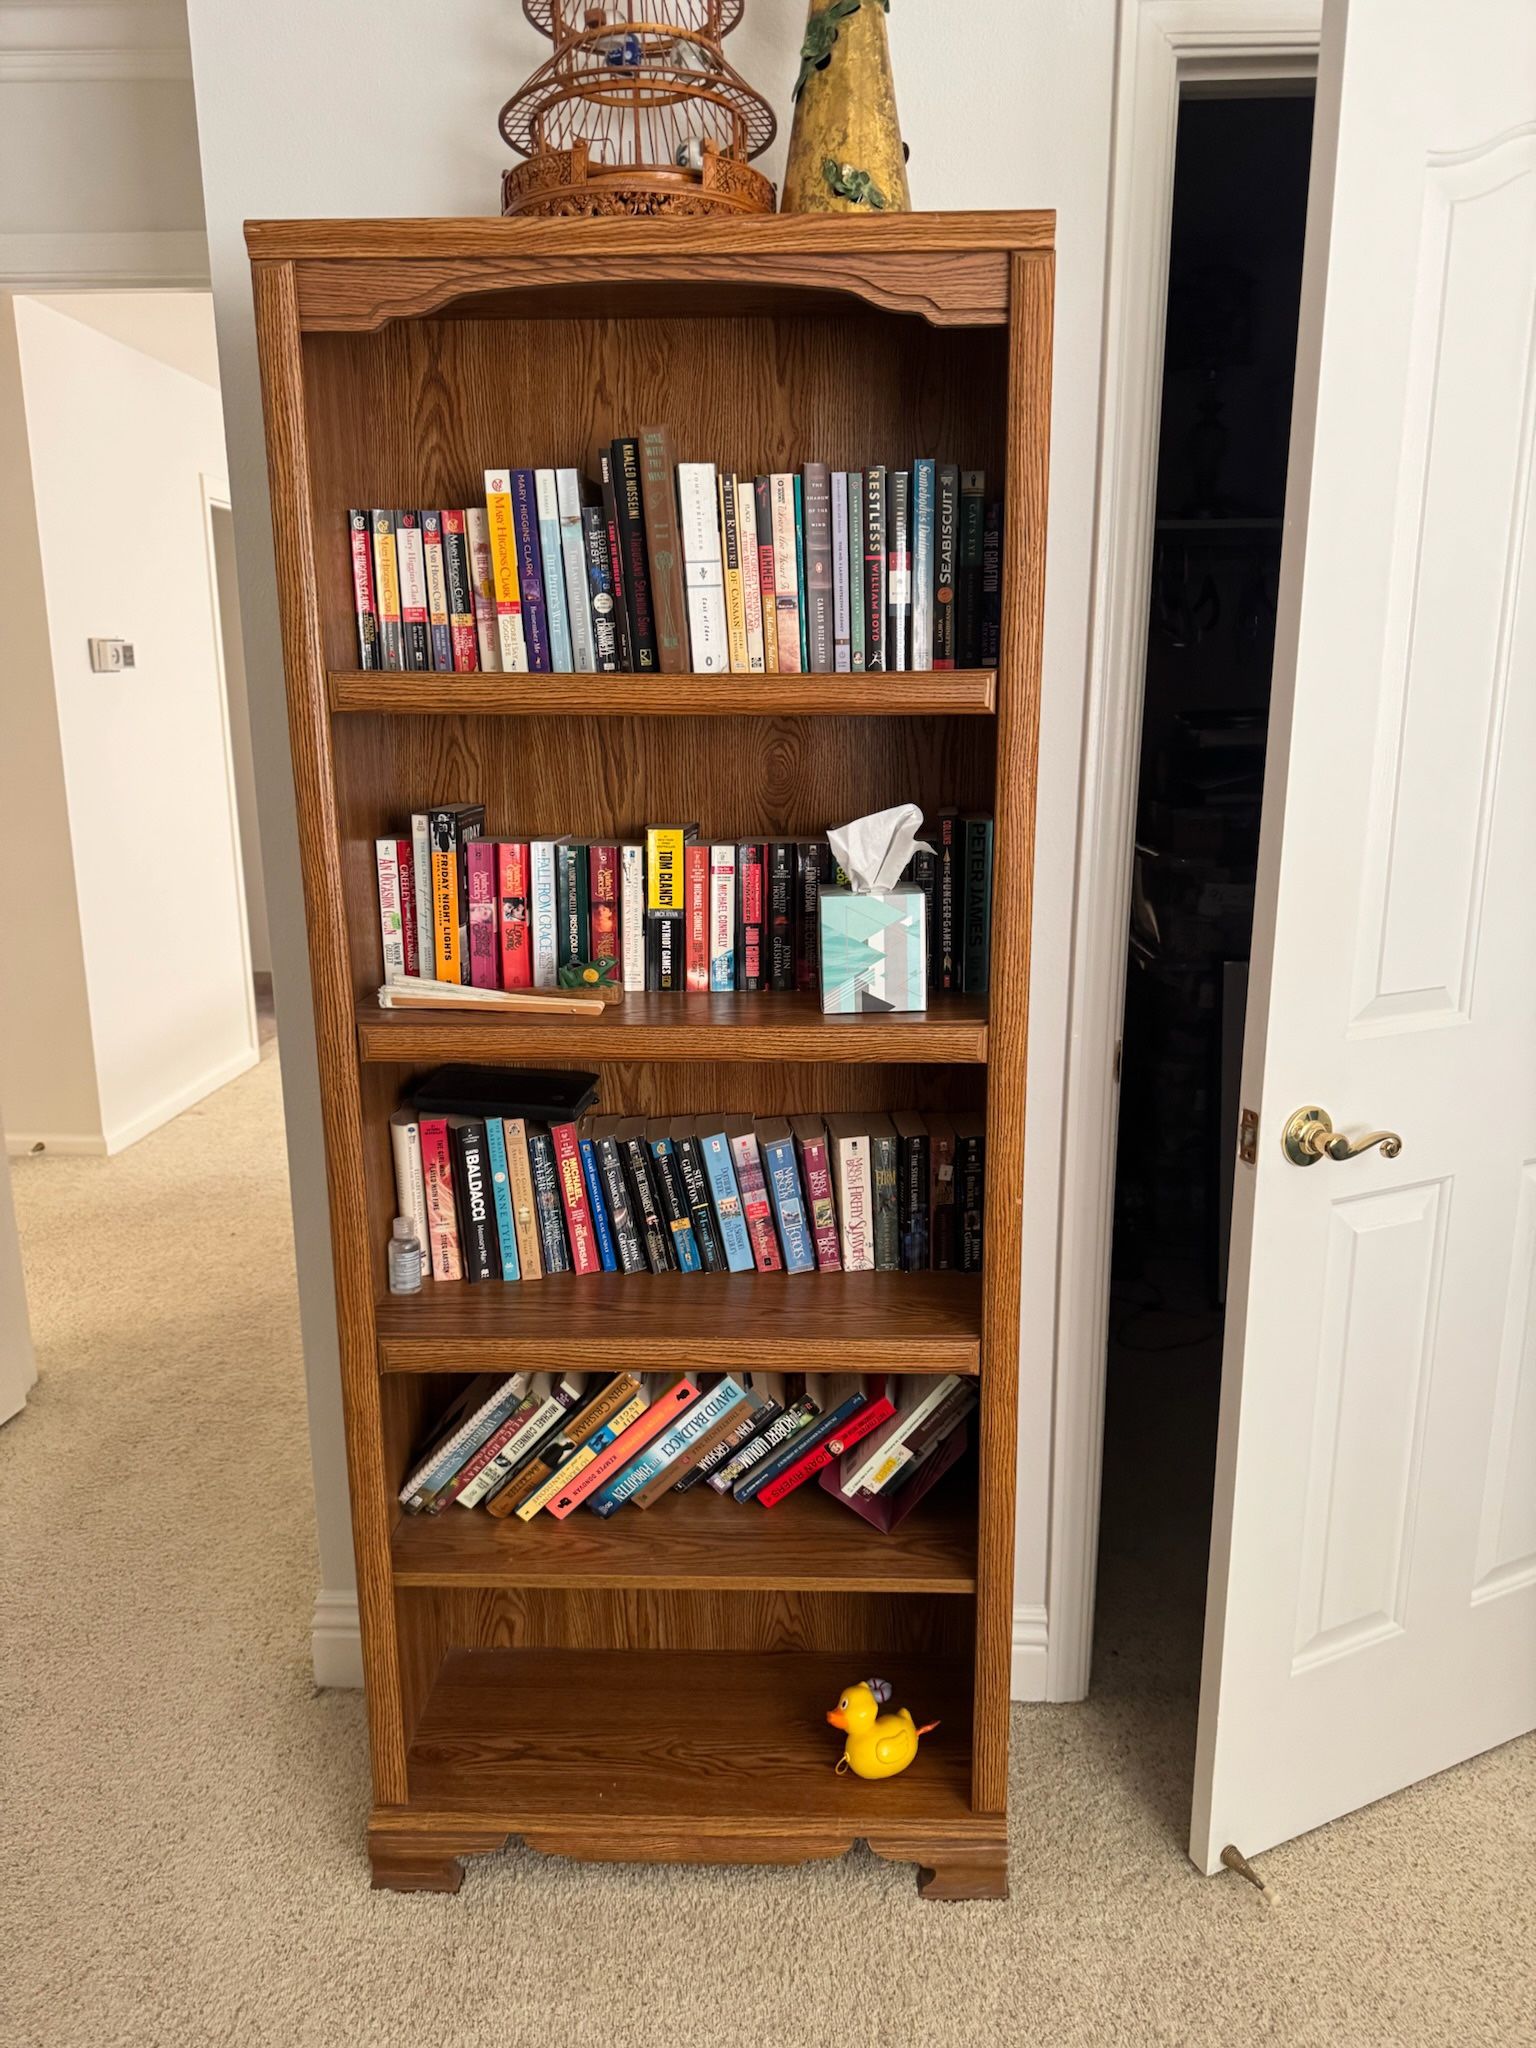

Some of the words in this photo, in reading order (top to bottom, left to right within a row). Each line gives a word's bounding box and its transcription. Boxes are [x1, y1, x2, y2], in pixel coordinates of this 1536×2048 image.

[601, 457, 609, 483] Nicholas
[622, 444, 635, 478] KHALED
[518, 475, 526, 502] MARY
[626, 480, 639, 520] HOSSEINI
[914, 465, 933, 522] Somebody's
[494, 497, 505, 525] MARY
[725, 493, 733, 515] THE
[868, 471, 881, 552] RESTLESS
[519, 505, 530, 542] HIGGINS
[968, 504, 977, 535] CAT'S
[404, 530, 415, 550] Mary
[449, 535, 458, 558] MARY
[497, 526, 508, 566] HIGGINS
[589, 532, 599, 565] NEST
[726, 520, 737, 567] RAPTURE
[917, 525, 931, 561] Darling
[940, 490, 953, 584] SEABISCUIT
[968, 538, 977, 558] EYE
[983, 531, 998, 550] SUE
[405, 552, 417, 582] Higgins
[451, 559, 461, 587] HIGGINS
[524, 546, 533, 576] CLARK
[597, 530, 610, 589] HORNET'S
[760, 548, 774, 592] HAMMETT
[983, 551, 998, 592] GRAFTON
[410, 584, 418, 605] Clark
[499, 567, 511, 599] CLARK
[630, 538, 643, 577] THOUSAND
[638, 617, 650, 636] SUNS
[871, 563, 879, 608] WILLIAM
[454, 588, 464, 613] CLARK
[702, 597, 710, 612] East
[731, 589, 740, 628] CANAAN
[765, 598, 773, 613] The
[530, 606, 540, 642] Remember
[766, 615, 775, 643] Maltese
[872, 614, 880, 641] BOYD
[767, 644, 777, 669] Falcon
[943, 820, 952, 845] COLLINS
[659, 851, 672, 870] TOM
[971, 823, 986, 882] PETER
[400, 864, 409, 902] GREELEY
[440, 854, 449, 890] FRIDAY
[538, 858, 551, 881] FALL
[471, 872, 482, 900] Greeley
[538, 882, 551, 913] FROM
[659, 873, 673, 906] CLANCY
[693, 883, 702, 909] MICHAEL
[717, 884, 727, 913] MICHAEL
[943, 877, 952, 918] HUNGER
[442, 894, 450, 922] NIGHT
[969, 888, 983, 946] JAMES
[513, 924, 524, 948] Love
[538, 914, 553, 951] GRACE
[661, 921, 671, 949] PATRIOT
[693, 911, 702, 941] CONNELLY
[718, 915, 728, 948] CONNELLY
[745, 926, 759, 945] JOHN
[943, 921, 952, 952] GAMES
[386, 944, 395, 964] GREELEY
[405, 921, 414, 971] PEACEMAKERS
[444, 927, 452, 961] LIGHTS
[773, 937, 783, 976] GRISHAM
[782, 945, 790, 969] JOHN
[662, 951, 671, 975] GAMES
[745, 946, 760, 977] GRISHAM
[429, 1163, 438, 1183] PLAYED
[534, 1156, 547, 1191] TYLER
[846, 1159, 857, 1185] BINCHY
[854, 1158, 864, 1183] MAEVE
[911, 1154, 919, 1167] THE
[466, 1155, 486, 1221] BALDACCI
[561, 1160, 576, 1208] CONNELLY
[569, 1158, 583, 1201] MICHAEL
[589, 1173, 598, 1195] HIGGINS
[607, 1170, 621, 1208] SUMMONS
[635, 1169, 644, 1183] THE
[658, 1155, 669, 1174] MARY
[664, 1175, 673, 1198] HIGGINS
[670, 1198, 680, 1219] CLARK
[681, 1159, 697, 1203] GRAFTON
[693, 1169, 704, 1188] SUE
[715, 1174, 724, 1195] Dunne
[721, 1167, 733, 1196] Dominick
[774, 1171, 787, 1200] BINCHY
[783, 1167, 796, 1195] MAEVE
[809, 1171, 821, 1196] BINCHY
[818, 1169, 828, 1193] MAEVE
[875, 1170, 896, 1186] FIRM
[911, 1167, 919, 1188] STREET
[497, 1187, 506, 1218] ANNE
[637, 1184, 650, 1214] TESTAMENT
[848, 1186, 864, 1219] FIREFLY
[911, 1189, 919, 1212] LAWYER
[477, 1224, 485, 1250] Memory
[501, 1224, 510, 1259] TYLER
[574, 1224, 588, 1269] REVERSAL
[618, 1232, 631, 1270] GRISHAM
[628, 1238, 639, 1260] JOHN
[647, 1231, 659, 1260] GRISHAM
[735, 1229, 744, 1250] Season
[785, 1226, 804, 1258] ECHOES
[817, 1238, 828, 1254] BUS
[849, 1220, 867, 1262] SUMMER
[963, 1231, 972, 1268] GRISHAM
[972, 1238, 981, 1260] JOHN
[442, 1250, 450, 1273] LARSSON
[607, 1377, 634, 1405] JOHN
[703, 1385, 738, 1419] DAVID
[533, 1403, 559, 1432] MICHAEL
[572, 1399, 612, 1439] GRISHAM
[612, 1401, 639, 1427] ENGER
[734, 1417, 756, 1439] JOHN
[455, 1415, 498, 1459] Whistling
[498, 1416, 524, 1443] ALICE
[509, 1426, 538, 1456] CONNELLY
[660, 1411, 710, 1459] BALDACCI
[763, 1414, 797, 1447] ROBERT
[434, 1453, 461, 1482] Season
[462, 1442, 502, 1485] HOFFMAN
[595, 1454, 618, 1476] KEMPER
[696, 1440, 731, 1473] GRISHAM
[737, 1437, 771, 1470] LUDLUM
[803, 1450, 830, 1473] JOAN
[504, 1464, 541, 1501] RACKETEER
[571, 1472, 597, 1497] DONOVAN
[611, 1461, 655, 1504] FORGOTTEN
[770, 1470, 803, 1498] RIVERS
